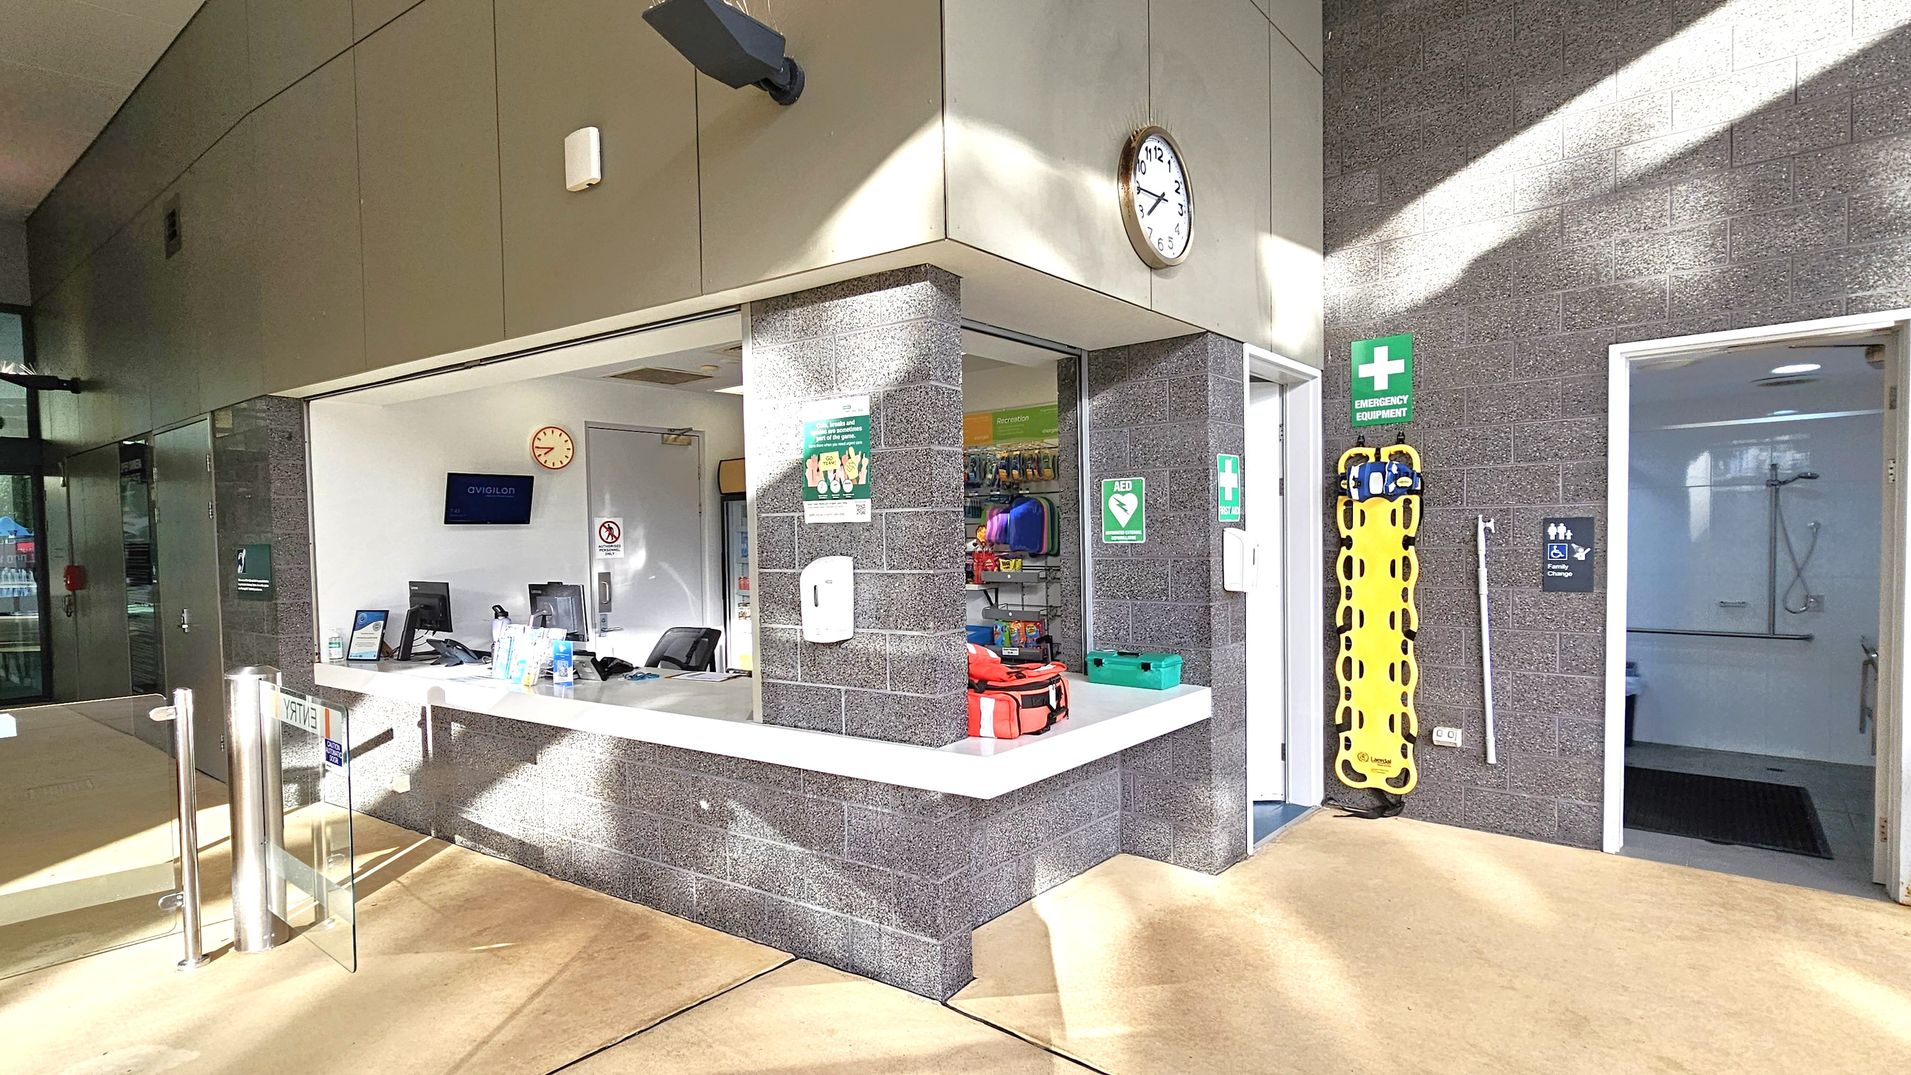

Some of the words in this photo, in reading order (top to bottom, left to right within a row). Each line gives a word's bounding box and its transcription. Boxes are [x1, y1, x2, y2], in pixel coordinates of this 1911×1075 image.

[1145, 146, 1152, 162] 11
[1154, 146, 1164, 163] 12
[1136, 158, 1147, 175] 10
[1167, 159, 1171, 173] 1
[1174, 180, 1181, 195] 2
[1178, 203, 1184, 217] 3
[1147, 226, 1153, 239] 7
[1174, 223, 1180, 236] 4
[1157, 238, 1164, 252] 6
[1168, 236, 1174, 250] 5
[1354, 395, 1409, 409] EMERGENCY
[996, 415, 1030, 425] Recreation
[1356, 407, 1408, 421] EQUIPMENT
[836, 426, 862, 434] sometimes
[1113, 480, 1133, 492] AED
[1547, 570, 1573, 578] Change
